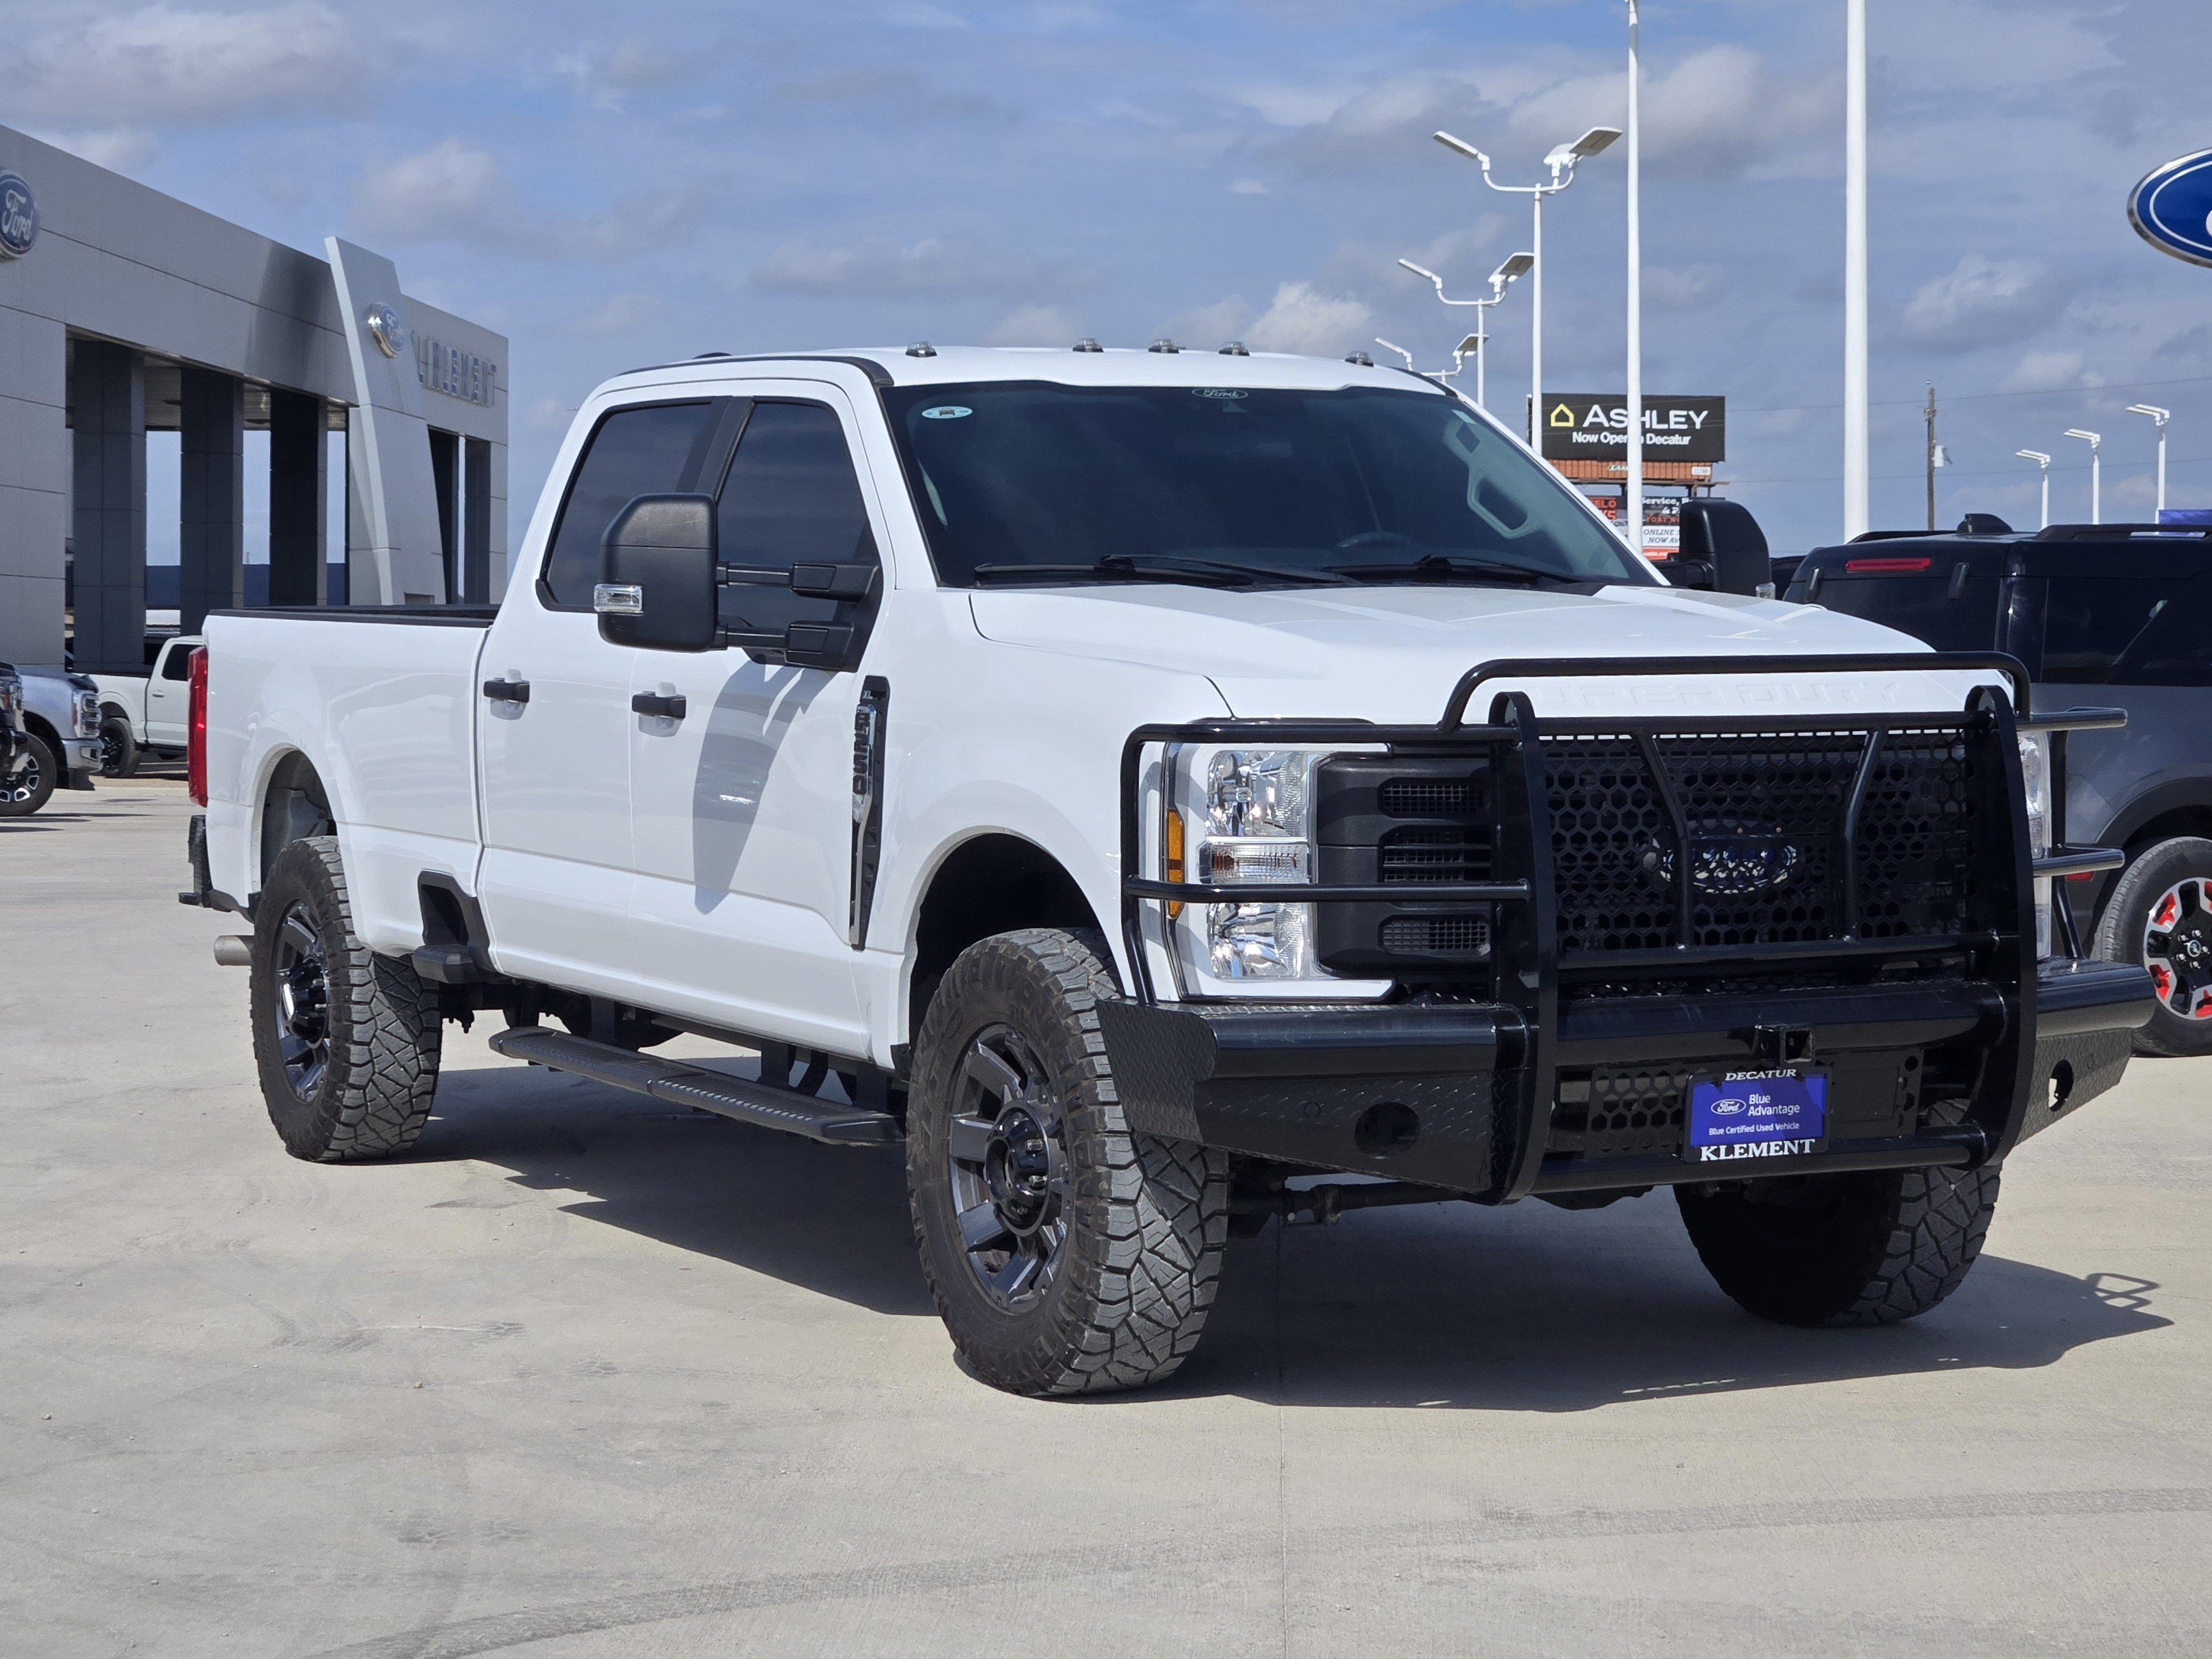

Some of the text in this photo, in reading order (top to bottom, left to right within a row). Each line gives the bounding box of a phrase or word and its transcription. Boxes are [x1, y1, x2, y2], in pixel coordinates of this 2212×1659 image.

[2, 189, 33, 241] Ford
[1572, 431, 1599, 443] Now
[1646, 433, 1691, 445] Decatur
[1725, 1069, 1797, 1081] DECATUR
[1749, 1094, 1771, 1105] Blue
[1748, 1105, 1800, 1117] Advantage
[1709, 1122, 1800, 1136] Blue Certified Used Vehicle
[1700, 1138, 1815, 1161] KLEMENT
